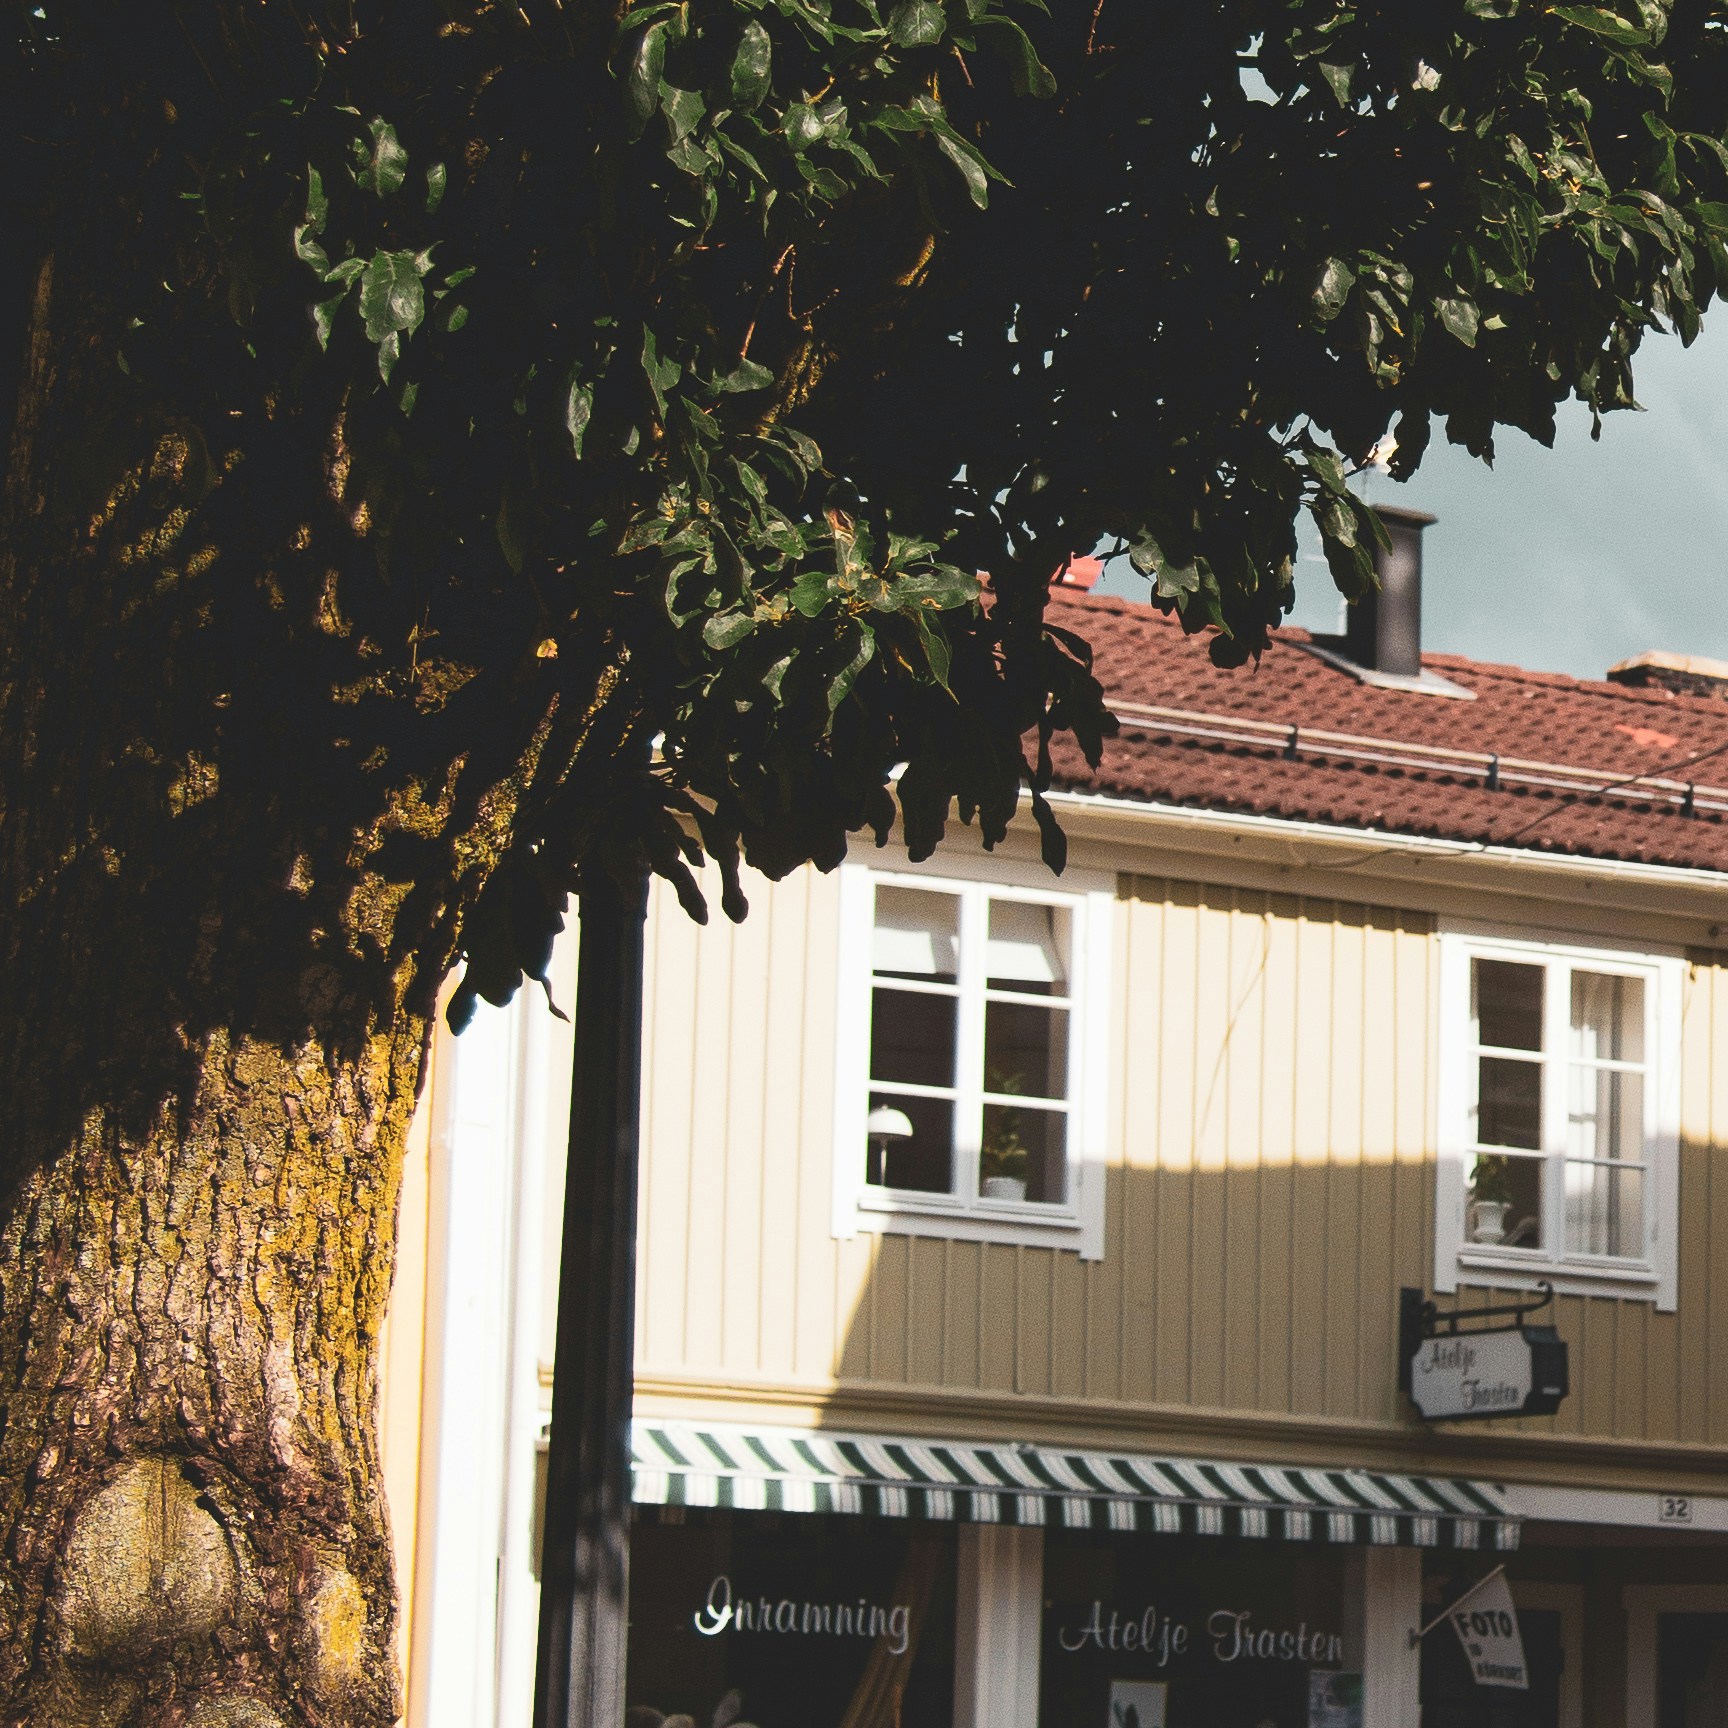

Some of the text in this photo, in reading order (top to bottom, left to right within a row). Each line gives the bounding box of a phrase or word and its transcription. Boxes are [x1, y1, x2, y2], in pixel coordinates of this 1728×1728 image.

[1664, 1497, 1688, 1518] 32
[693, 1573, 912, 1656] Inramning
[1058, 1598, 1344, 1668] Atelje Trasten
[1455, 1609, 1513, 1638] FOTO
